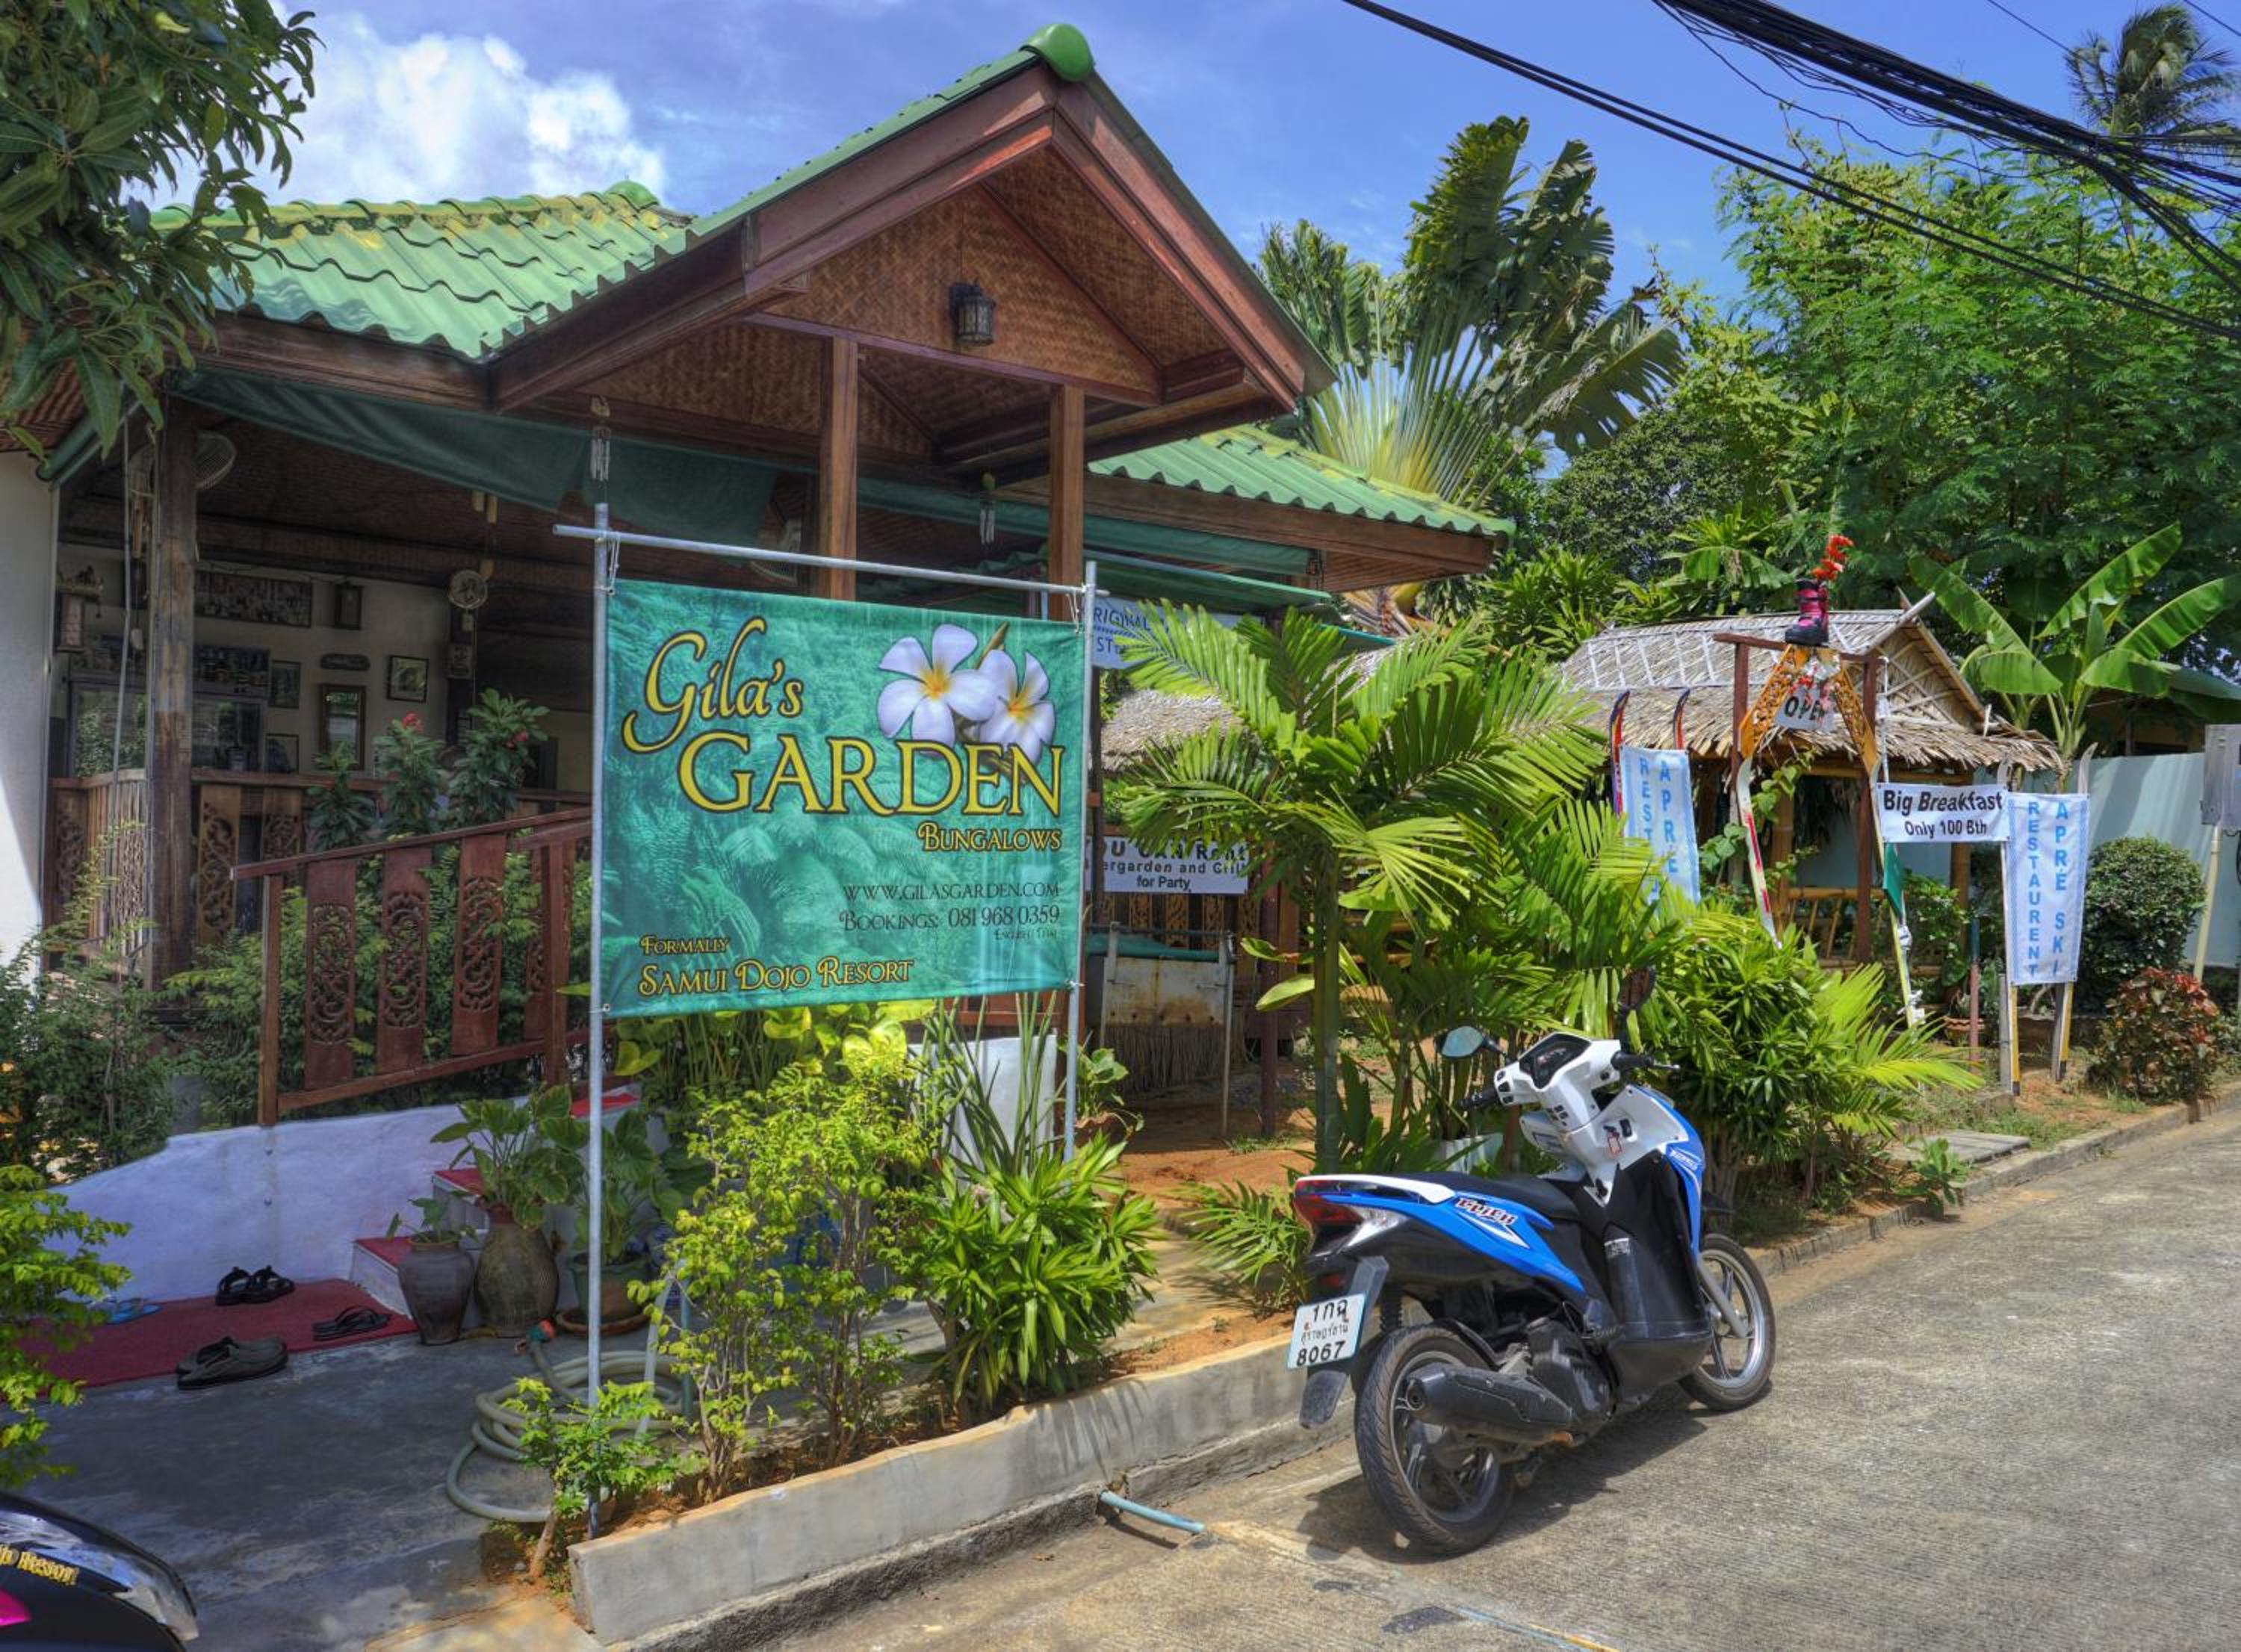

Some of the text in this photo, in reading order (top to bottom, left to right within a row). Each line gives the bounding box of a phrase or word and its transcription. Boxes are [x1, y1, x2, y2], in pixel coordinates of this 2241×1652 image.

[1094, 607, 1151, 630] RIGINAL
[622, 617, 804, 754] Gila's
[678, 732, 1065, 816] GARDEN
[1883, 789, 2003, 816] Big Breakfast
[917, 822, 1061, 851] BUNGALOWS
[1905, 819, 1987, 838] Only 100 Bth
[1102, 860, 1171, 875] ergarden
[1180, 861, 1206, 873] and
[843, 882, 1059, 901] WWW.GILASGARDEN.COM
[1136, 875, 1155, 888] for
[2028, 801, 2040, 978] RESTAURENT
[947, 907, 977, 927] 081
[981, 906, 1014, 926] 968
[1017, 904, 1060, 925] 0359
[639, 934, 730, 955] FORMALLY
[2053, 912, 2066, 978] SKI
[639, 957, 914, 996] SAMUI DOJO RESORT
[1296, 1341, 1346, 1366] 8067
